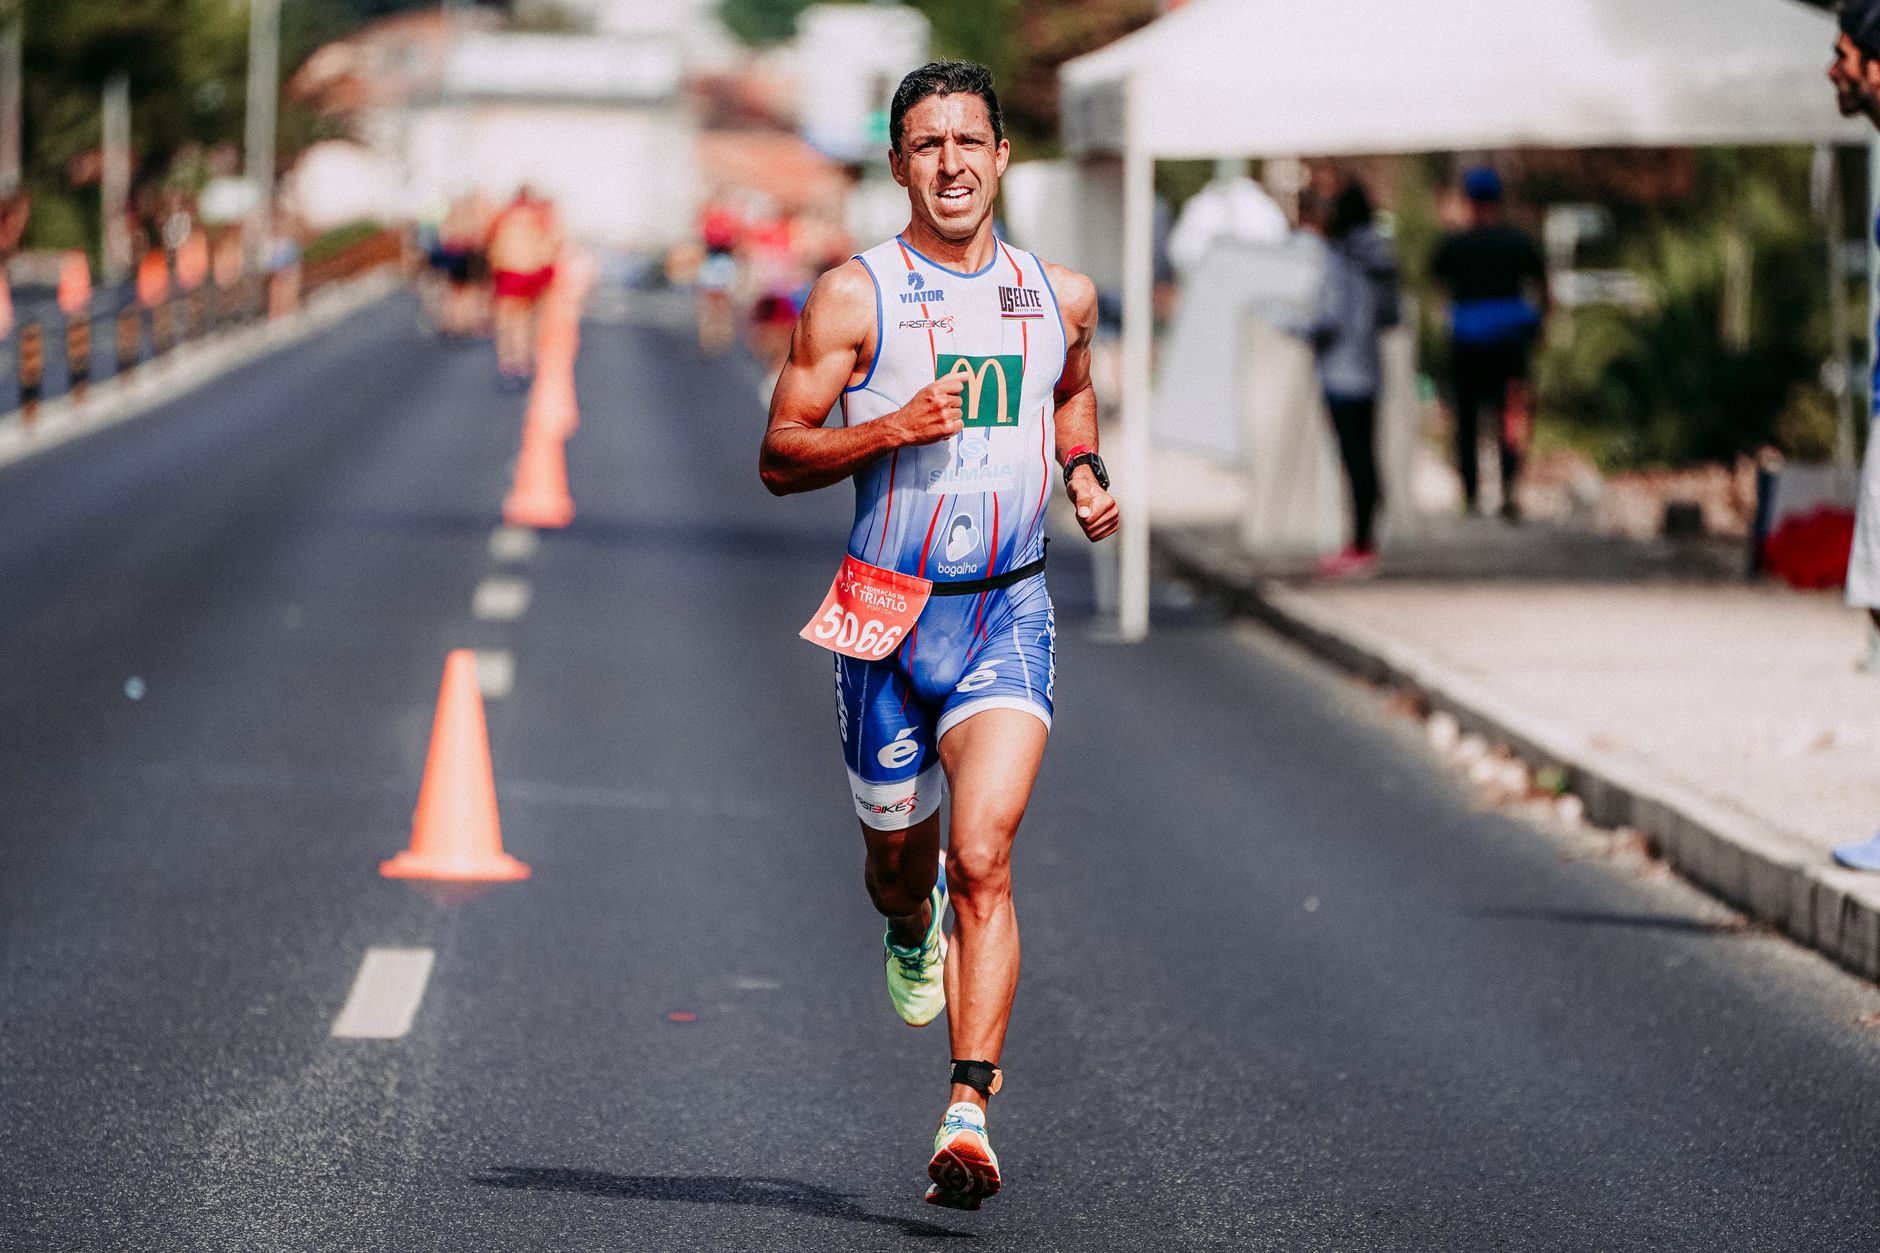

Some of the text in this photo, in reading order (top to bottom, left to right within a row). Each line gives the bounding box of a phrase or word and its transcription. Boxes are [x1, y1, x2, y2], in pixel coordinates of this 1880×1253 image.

[899, 289, 945, 304] VIATOR
[929, 464, 1012, 483] SILMAIA
[938, 562, 978, 578] bogalha
[863, 586, 897, 598] FEDERAÇÃO
[859, 590, 907, 613] TRIATLO
[866, 604, 895, 616] PORTUGAL
[815, 604, 902, 656] 5066
[877, 725, 919, 769] é
